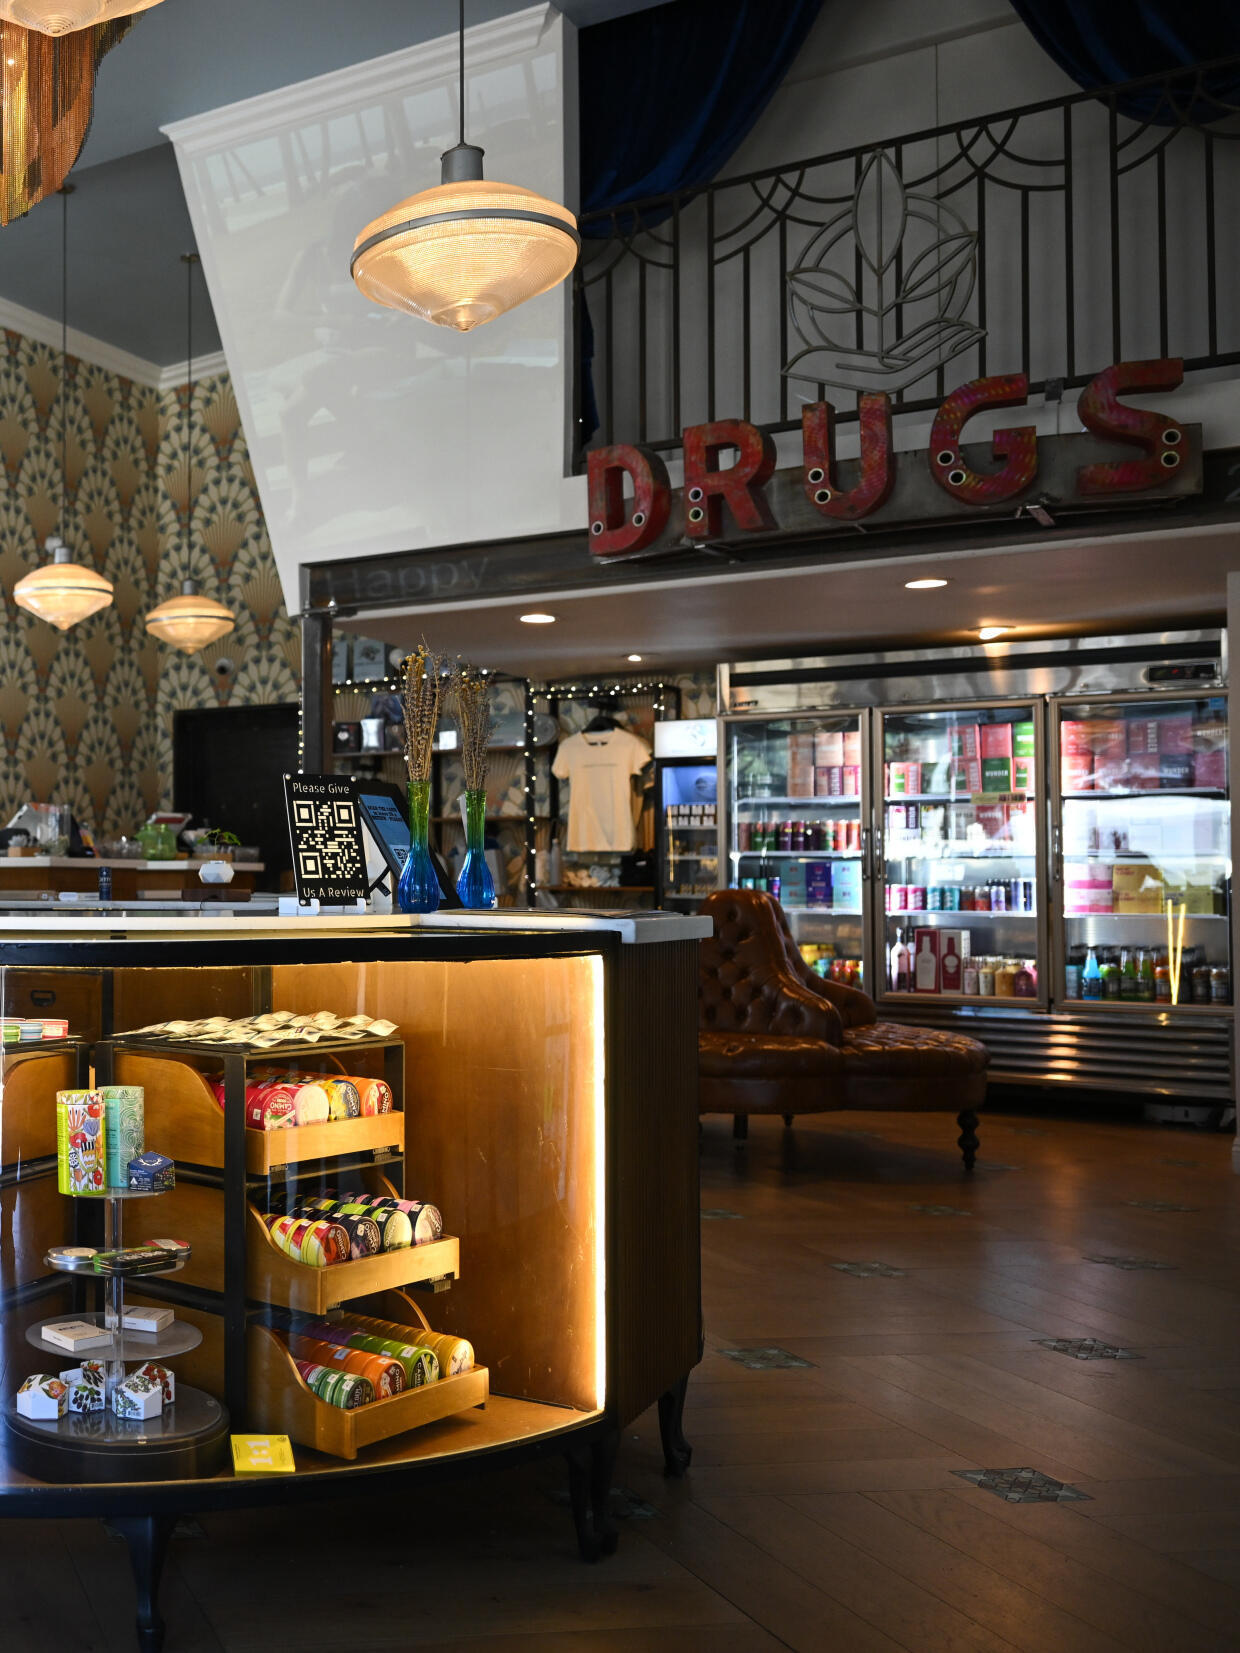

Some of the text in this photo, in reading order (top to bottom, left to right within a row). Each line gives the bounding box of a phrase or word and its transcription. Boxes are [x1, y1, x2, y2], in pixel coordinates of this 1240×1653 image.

[587, 358, 1192, 558] DRUGS
[324, 556, 489, 599] Happy
[292, 782, 351, 795] Please Give
[303, 886, 364, 898] Us A Review
[270, 1102, 292, 1111] CAMINO
[347, 1086, 358, 1116] CAMINO
[428, 1208, 441, 1232] CAMINO
[336, 1229, 347, 1260] CAMINO
[365, 1223, 377, 1254] CAMINO
